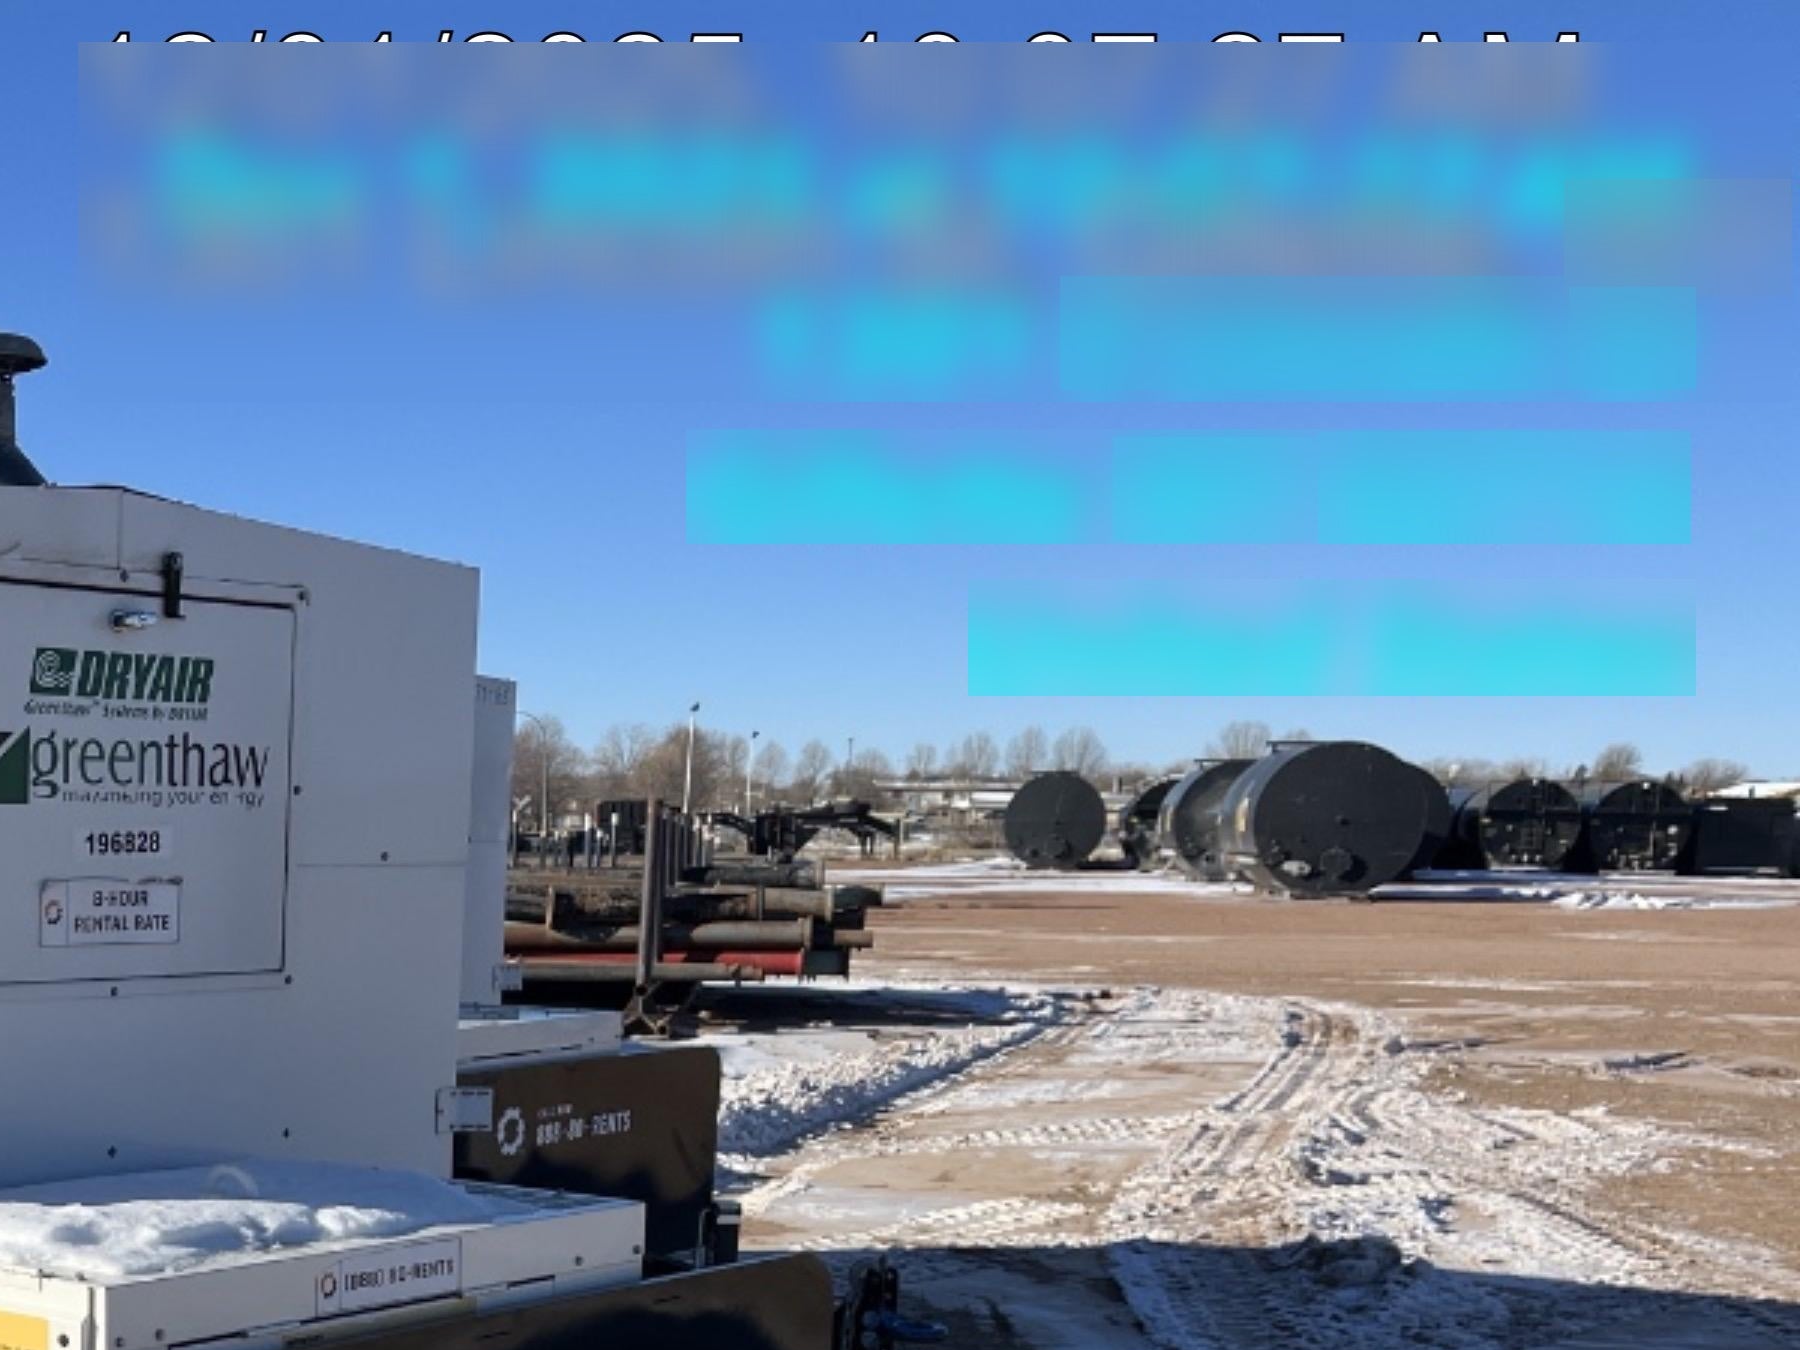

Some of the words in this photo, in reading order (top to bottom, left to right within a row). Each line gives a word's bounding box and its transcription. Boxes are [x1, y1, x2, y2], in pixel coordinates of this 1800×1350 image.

[74, 650, 214, 703] DRYAIR
[32, 729, 271, 799] greenthaw
[85, 830, 160, 856] 196828
[74, 914, 129, 933] RENTAL
[134, 914, 170, 931] RATE
